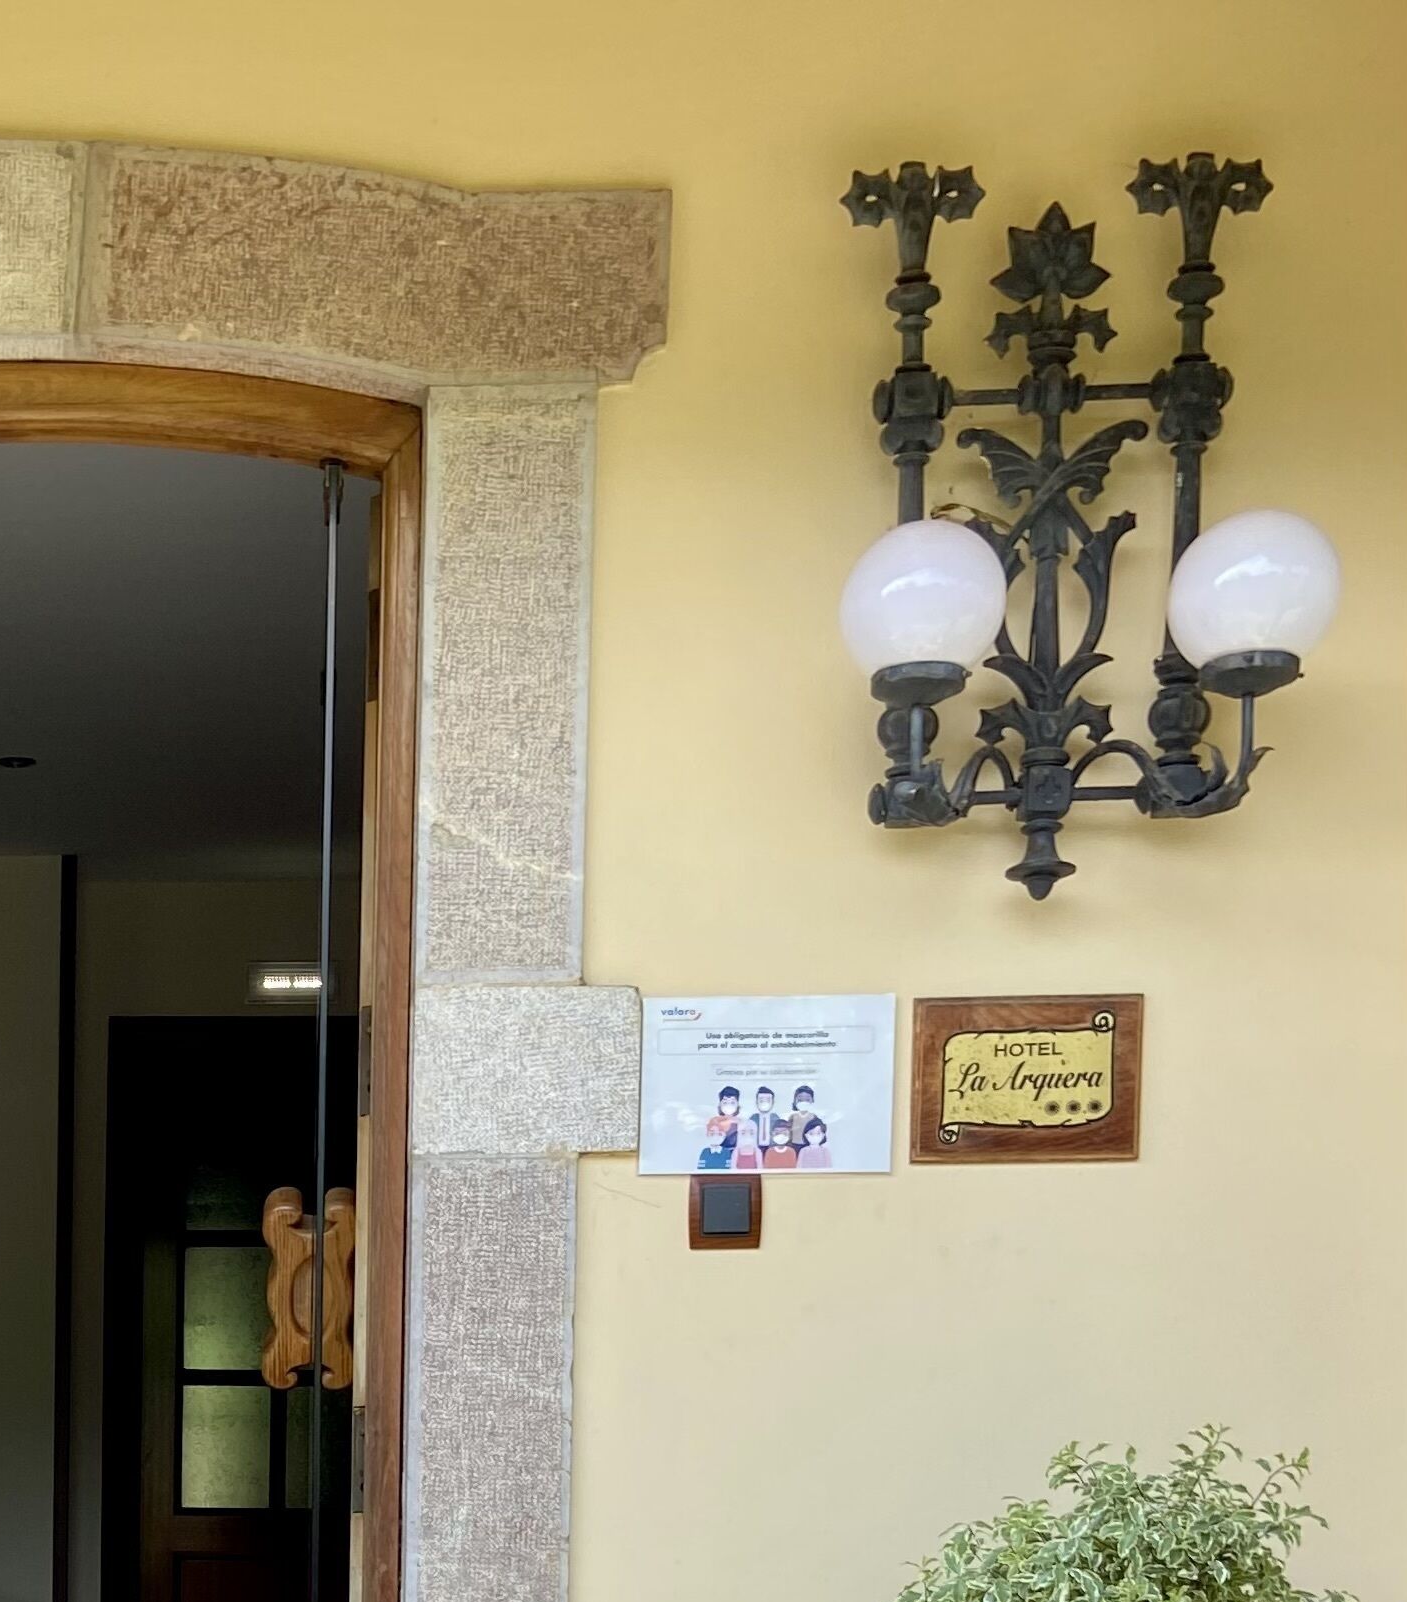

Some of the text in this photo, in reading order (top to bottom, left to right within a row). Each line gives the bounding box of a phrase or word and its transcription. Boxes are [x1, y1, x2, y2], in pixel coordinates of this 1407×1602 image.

[697, 1042, 718, 1050] para
[720, 1041, 728, 1049] el
[994, 1041, 1063, 1058] HOTEL
[948, 1060, 1104, 1101] La Arquera
